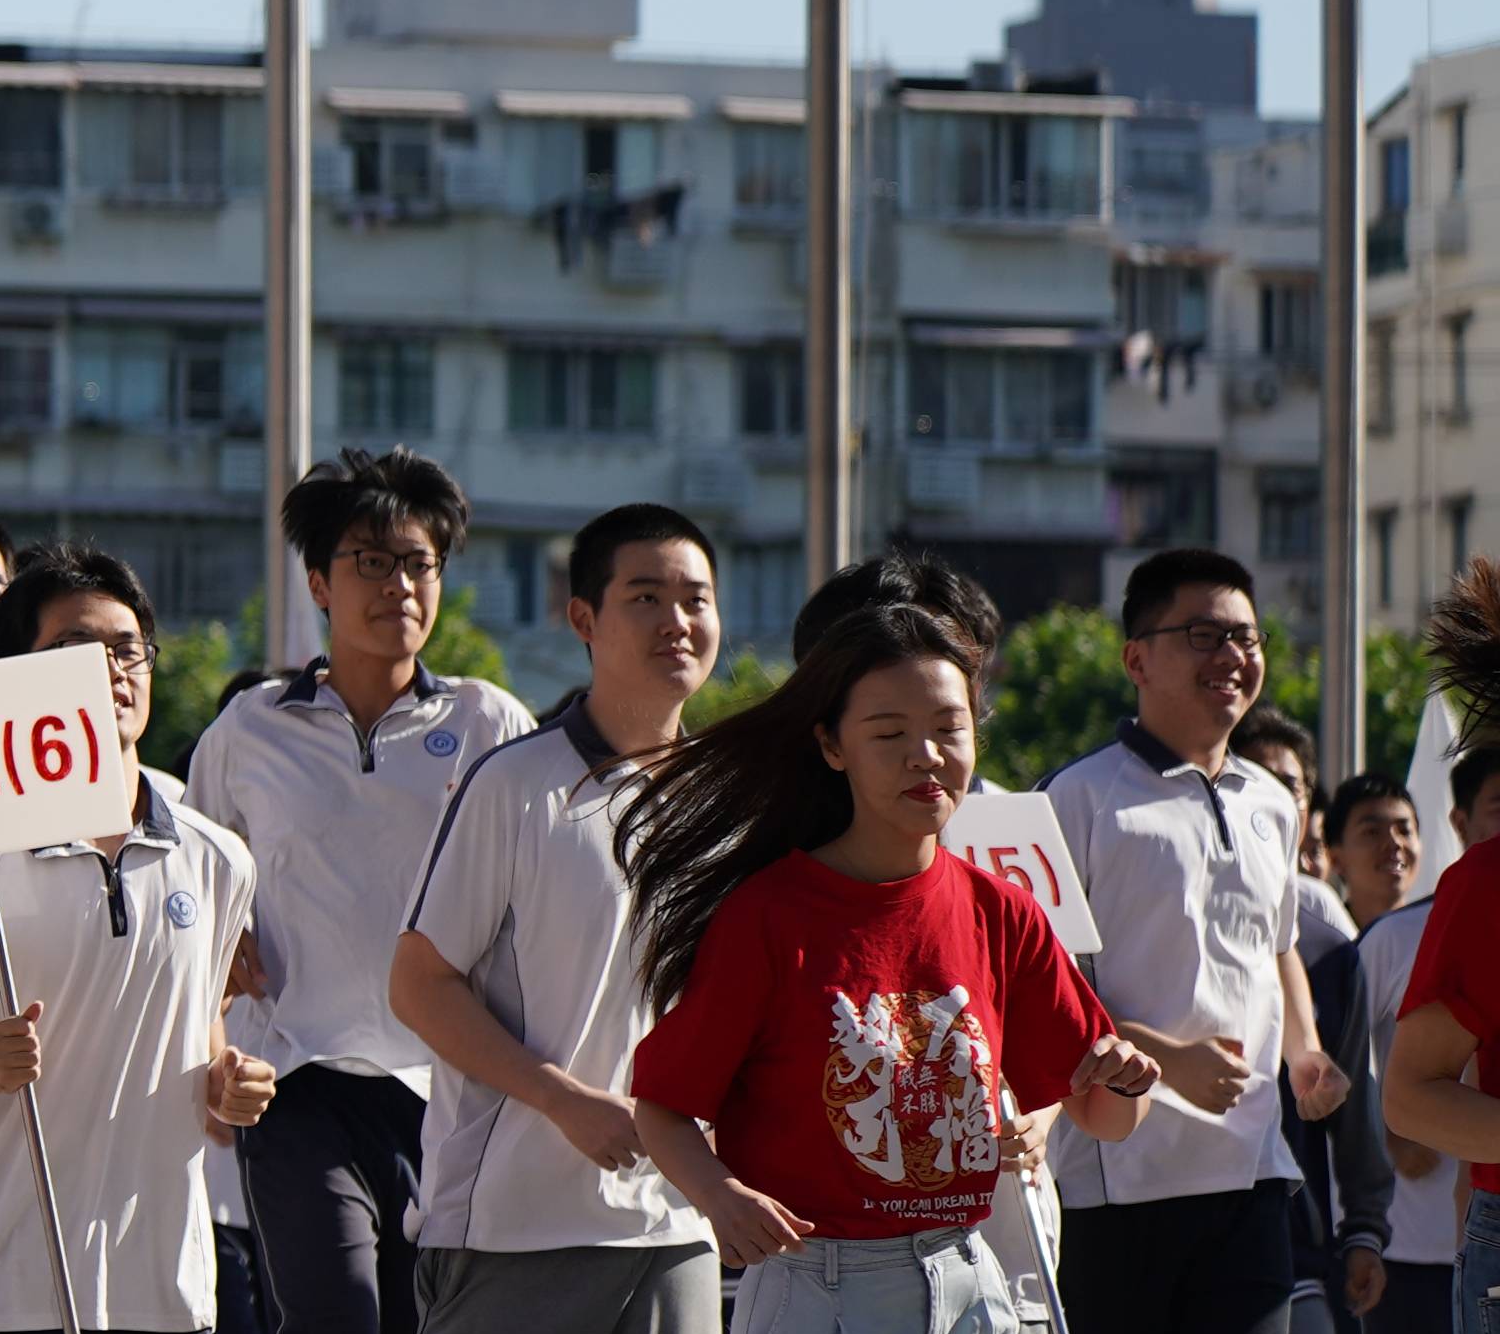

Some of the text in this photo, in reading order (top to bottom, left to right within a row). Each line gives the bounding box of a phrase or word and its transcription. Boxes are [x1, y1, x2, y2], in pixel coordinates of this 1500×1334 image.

[880, 1199, 907, 1212] YOU
[909, 1198, 931, 1211] CAN
[934, 1194, 976, 1209] DREAM
[979, 1192, 993, 1205] IT
